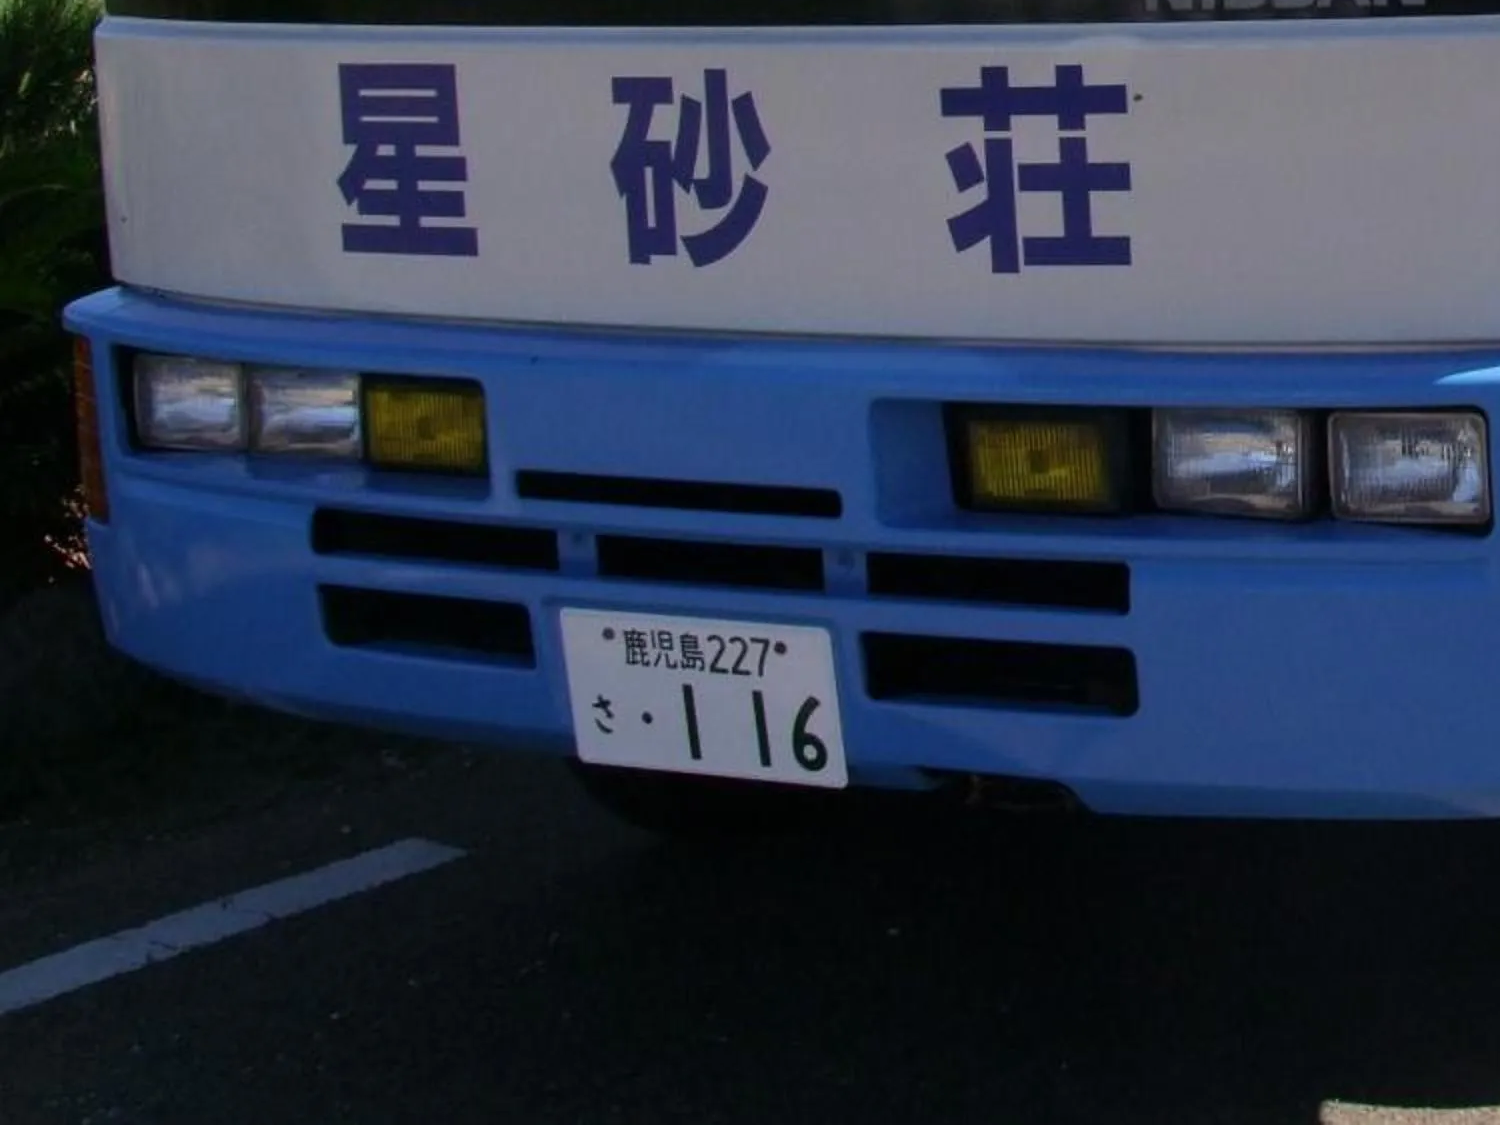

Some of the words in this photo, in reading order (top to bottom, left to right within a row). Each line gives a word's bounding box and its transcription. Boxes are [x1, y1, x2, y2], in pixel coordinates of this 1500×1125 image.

[336, 63, 1133, 274] 星砂荘
[622, 628, 771, 678] 鹿児島227
